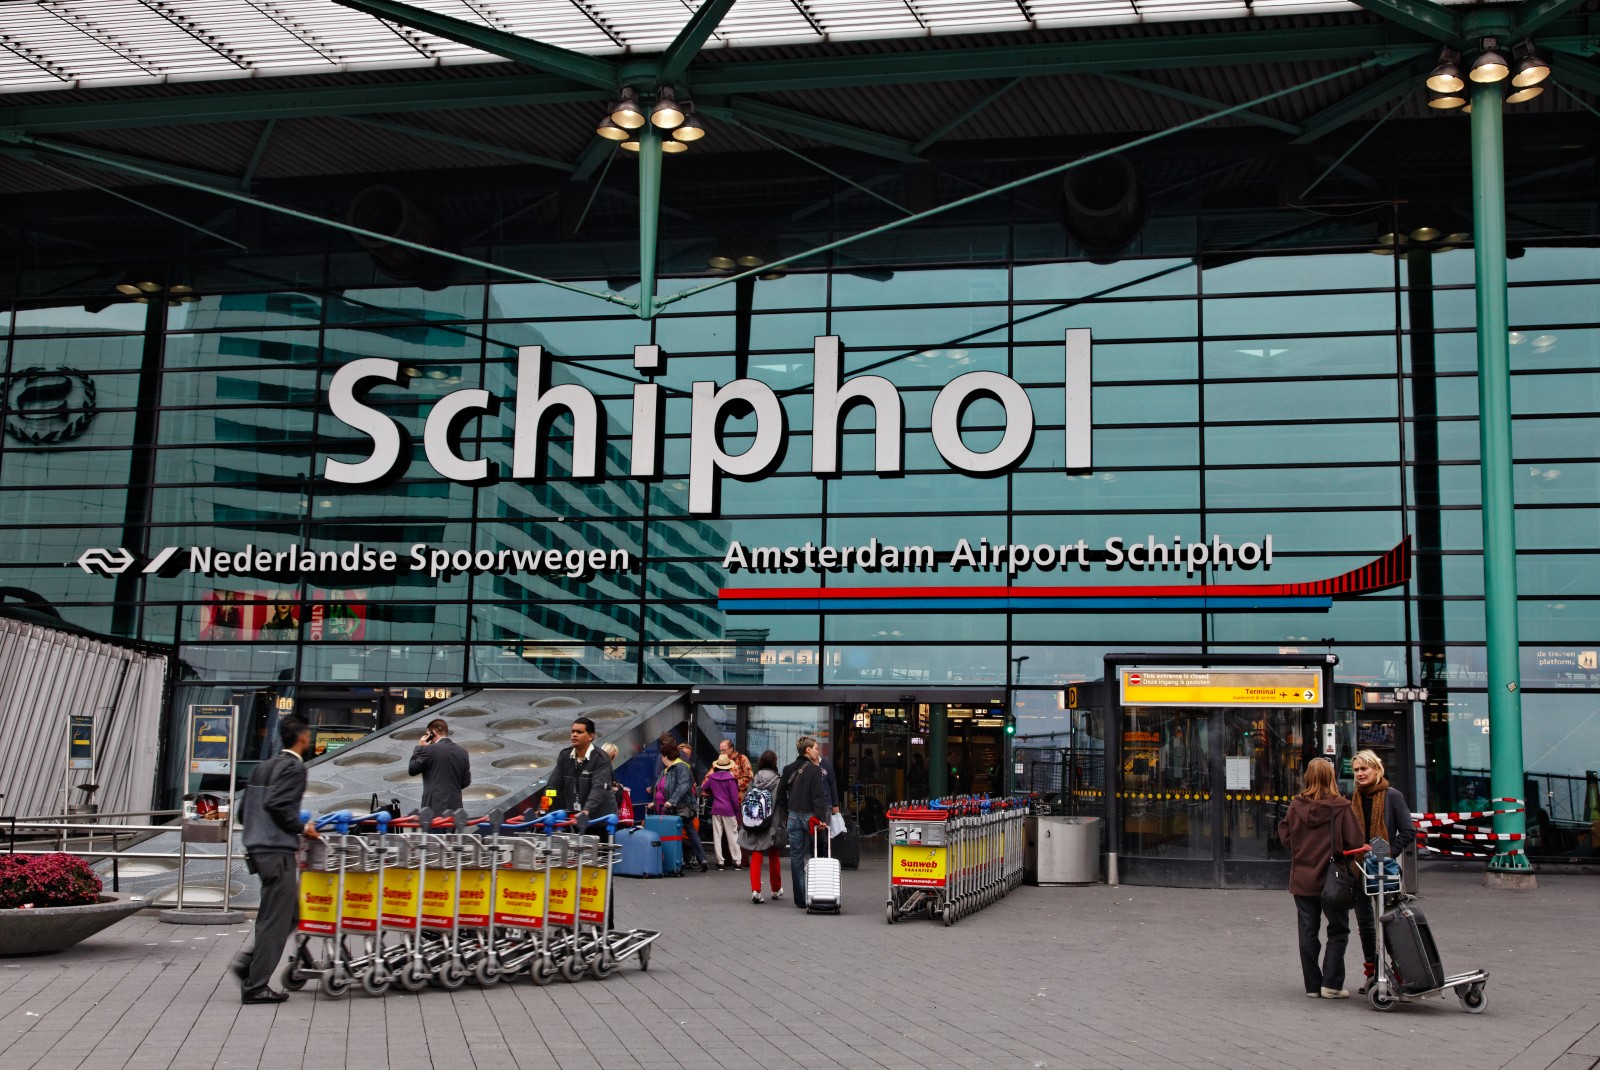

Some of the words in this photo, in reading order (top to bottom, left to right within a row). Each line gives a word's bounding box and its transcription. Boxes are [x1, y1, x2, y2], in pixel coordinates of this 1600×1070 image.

[324, 328, 1092, 514] Schiphol
[722, 538, 935, 570] Amsterdam
[950, 537, 1090, 574] Airport
[1105, 534, 1272, 572] Schiphol
[190, 542, 397, 573] Nederlandse
[410, 542, 630, 580] Spoorwegen
[1071, 690, 1075, 705] D
[1356, 691, 1361, 706] D
[901, 859, 937, 868] Sunweb
[384, 887, 412, 900] Sunweb
[424, 890, 449, 900] unweb
[460, 889, 484, 899] unweb
[503, 888, 536, 901] Sunweb
[550, 888, 568, 898] web
[581, 886, 598, 896] web
